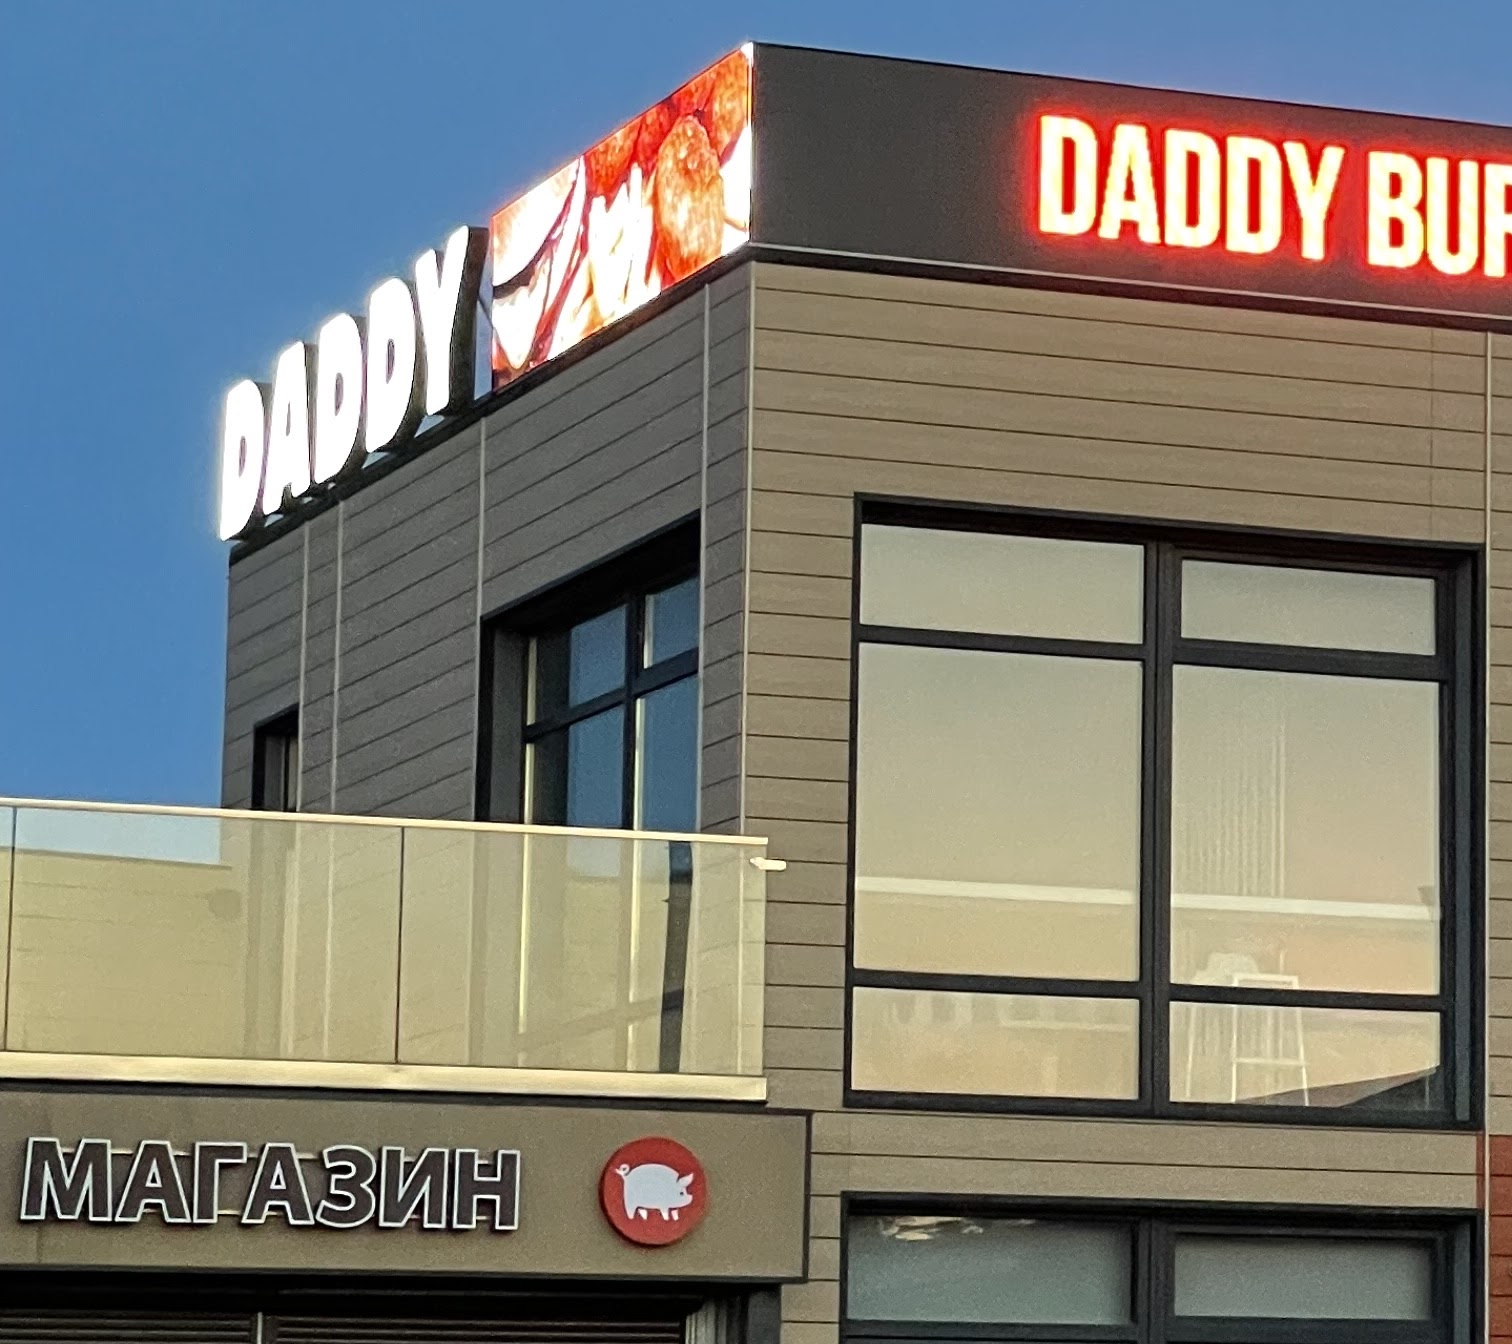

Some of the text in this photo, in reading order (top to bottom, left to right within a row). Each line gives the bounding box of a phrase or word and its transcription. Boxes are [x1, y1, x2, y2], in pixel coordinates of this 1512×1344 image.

[1037, 114, 1347, 261] DADDY
[219, 225, 474, 541] DADDY
[20, 1137, 521, 1229] МАГАЗИН
